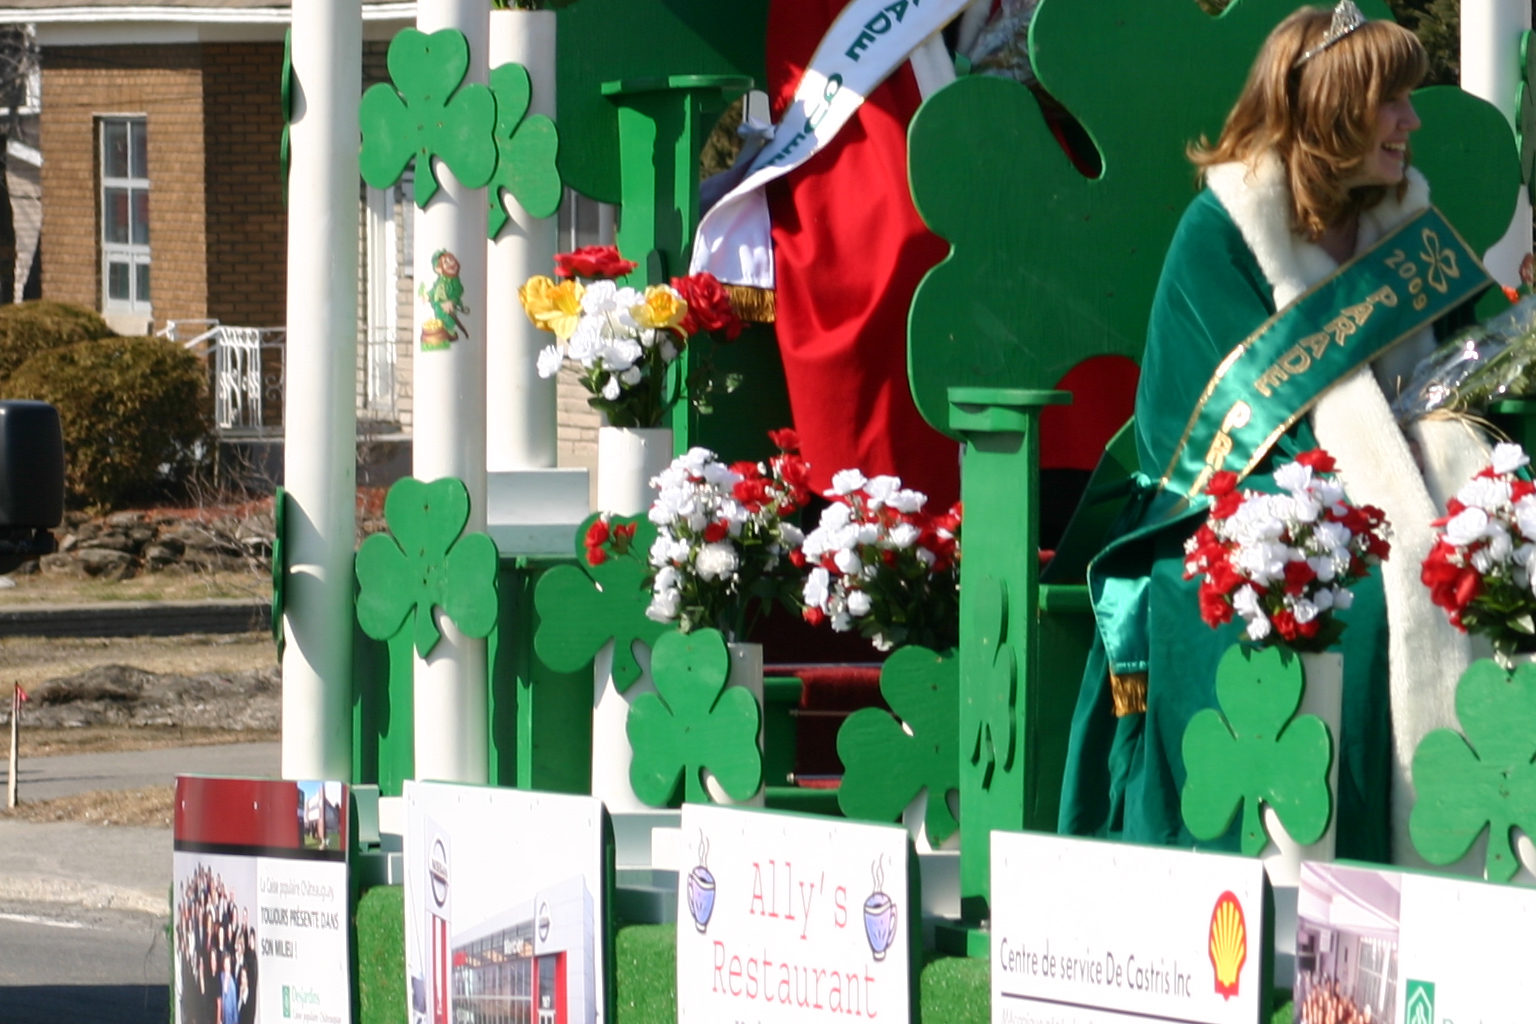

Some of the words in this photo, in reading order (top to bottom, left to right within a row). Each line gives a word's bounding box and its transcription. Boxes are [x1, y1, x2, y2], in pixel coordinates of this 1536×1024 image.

[1383, 248, 1427, 311] 2009
[1254, 284, 1398, 398] PARADE
[320, 911, 339, 930] DANS
[749, 859, 848, 940] Ally's
[261, 937, 274, 956] SON
[1000, 936, 1039, 976] Centre
[1041, 937, 1057, 978] de
[1060, 947, 1103, 985] service
[1106, 950, 1123, 988] De
[1126, 953, 1171, 995] Castris
[1173, 959, 1192, 998] Inc
[711, 939, 878, 1020] Restaurant
